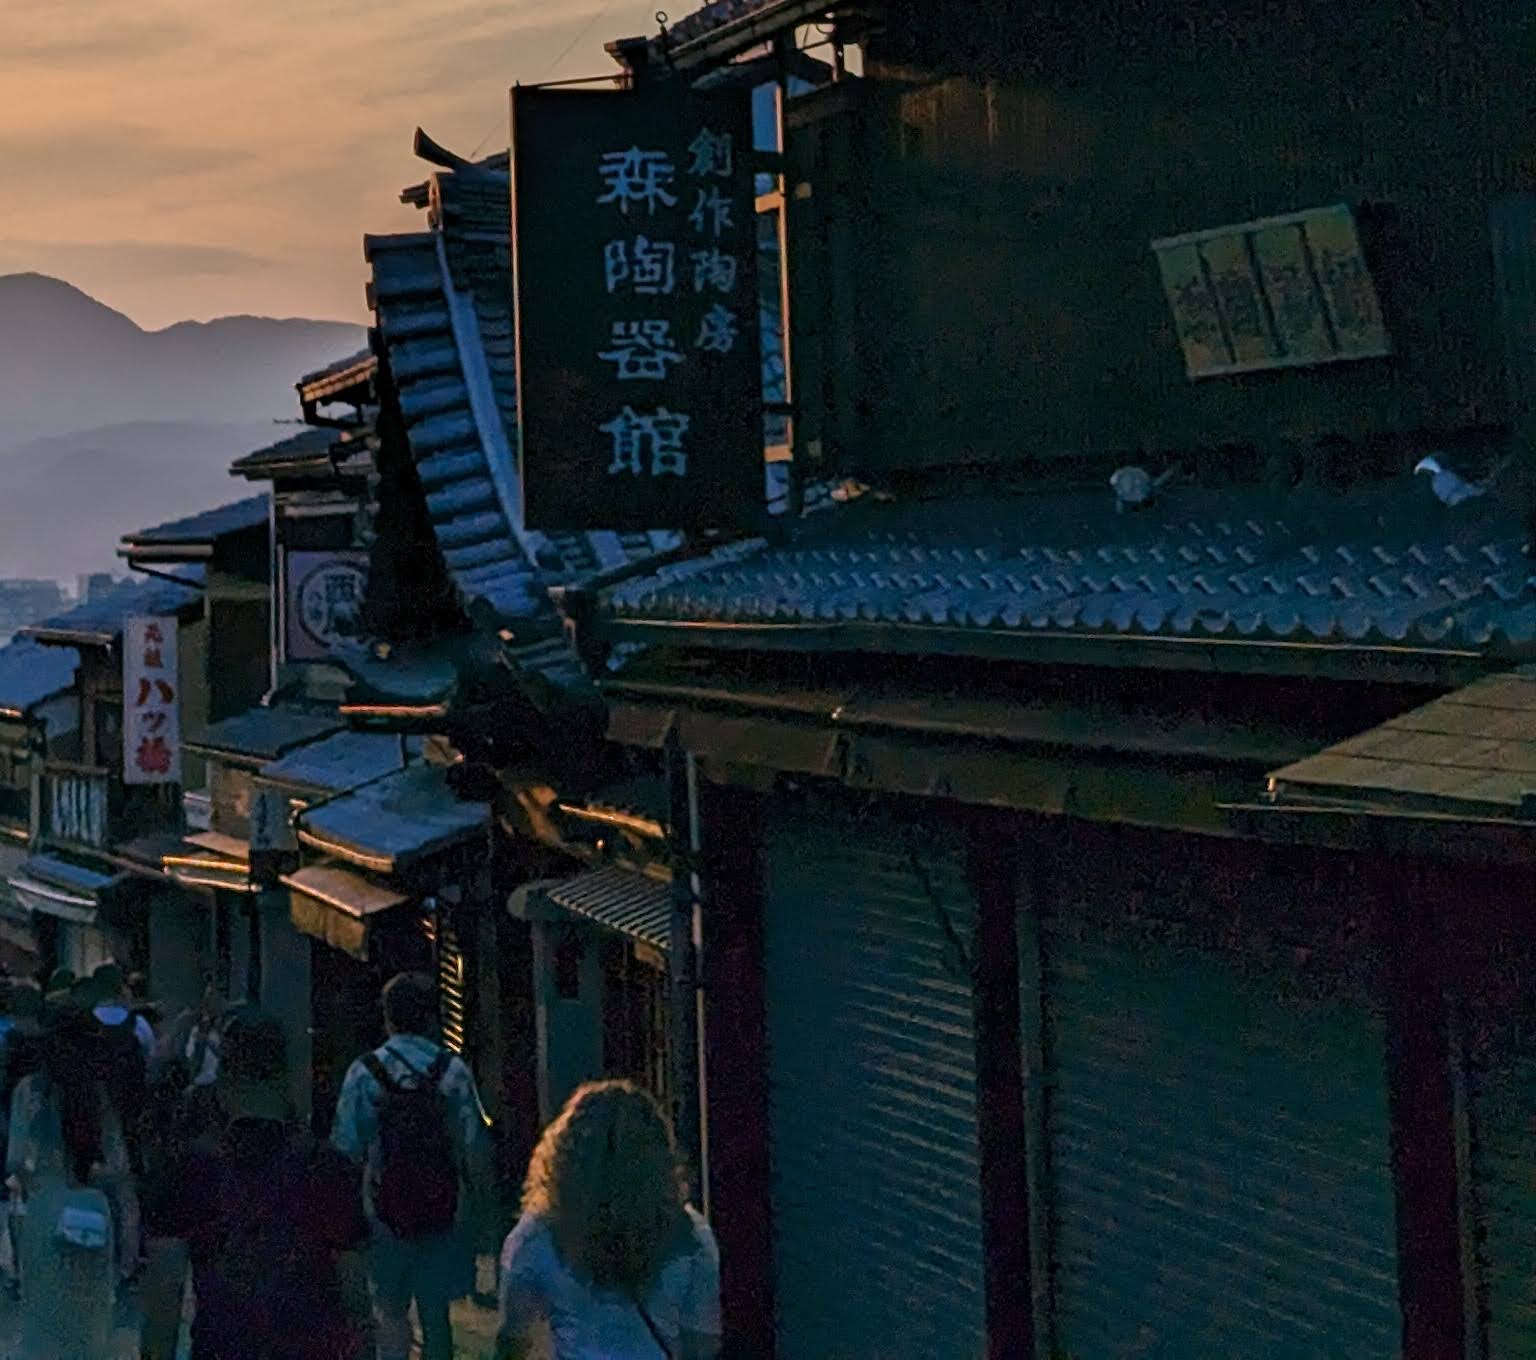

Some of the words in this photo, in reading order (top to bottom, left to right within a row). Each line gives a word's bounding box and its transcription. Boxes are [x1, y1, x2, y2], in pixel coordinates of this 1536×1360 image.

[596, 144, 690, 478] 森陶器館
[686, 126, 739, 354] 創作陶房
